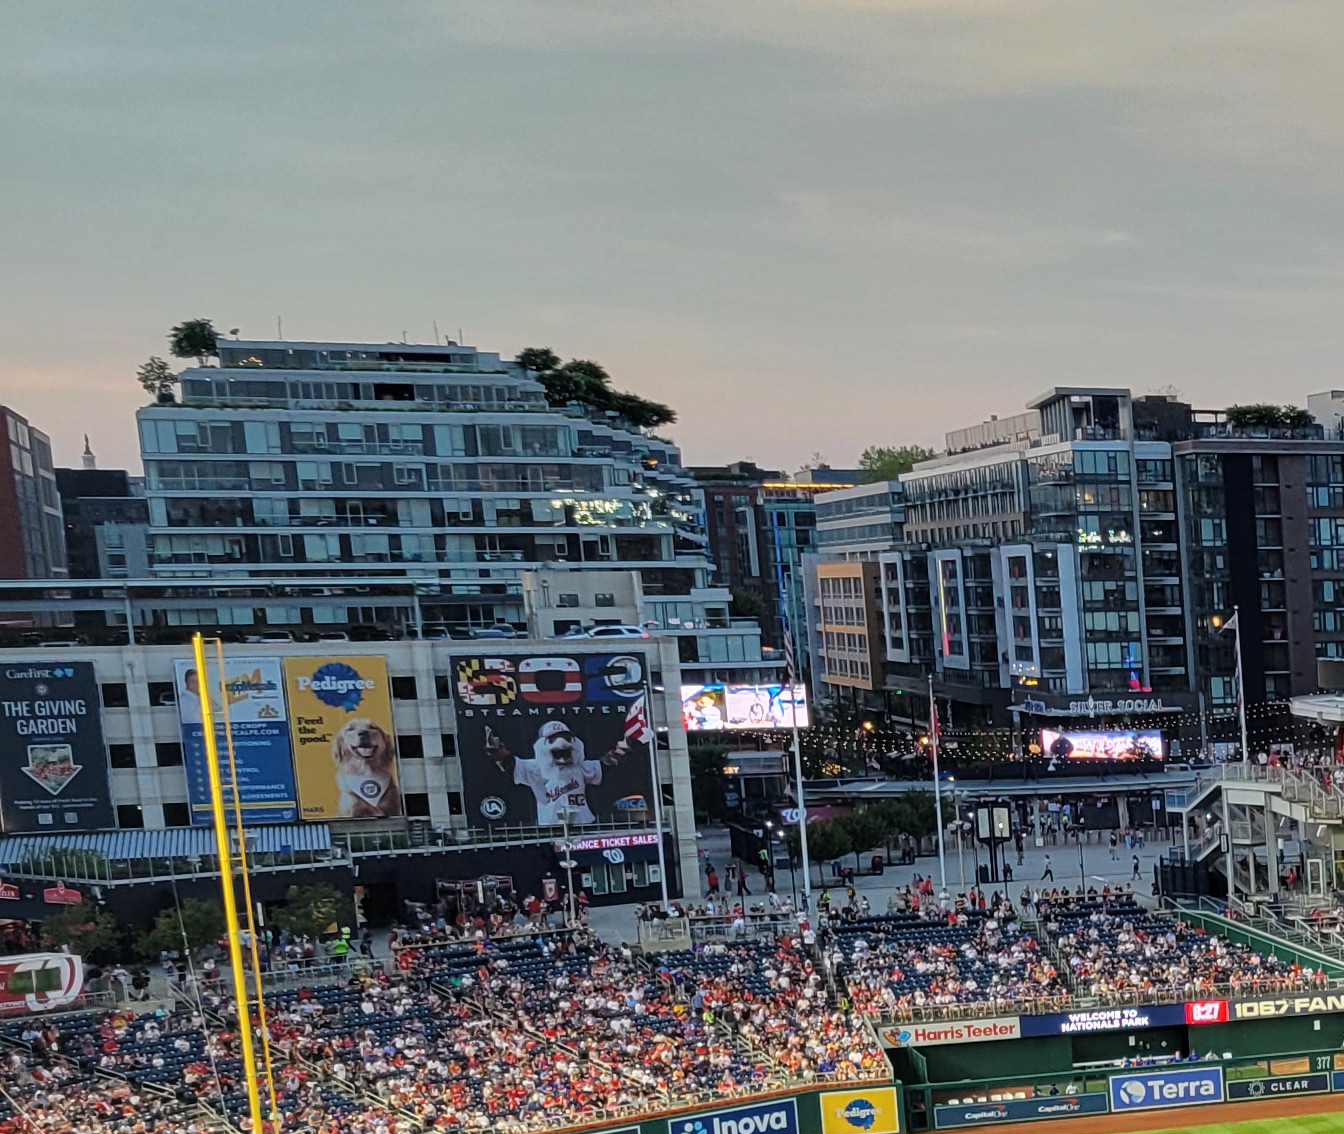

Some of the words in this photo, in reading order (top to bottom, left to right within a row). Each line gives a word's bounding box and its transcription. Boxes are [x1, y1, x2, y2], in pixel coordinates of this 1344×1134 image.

[6, 668, 51, 679] CareFirst
[296, 676, 375, 694] Pedigree
[4, 701, 31, 717] THE
[34, 700, 86, 716] GIVING
[463, 706, 628, 717] STEAMFITTER
[1069, 701, 1113, 714] SILVER
[1117, 699, 1163, 712] SOCIAL
[17, 718, 77, 735] GARDEN
[297, 716, 324, 725] Feed
[298, 726, 316, 734] the
[601, 836, 630, 848] TICKET
[632, 834, 659, 846] SALES
[1069, 1011, 1120, 1023] WELCOME
[1122, 1009, 1138, 1020] TO
[1192, 1003, 1220, 1021] 8:27
[1061, 1019, 1119, 1033] NATIONALS
[1121, 1016, 1149, 1028] PARK
[914, 1027, 963, 1043] Harris
[964, 1023, 1016, 1039] Teeter
[1316, 1056, 1331, 1070] 377
[1147, 1077, 1215, 1101] Terra
[1270, 1079, 1307, 1092] CLEAR
